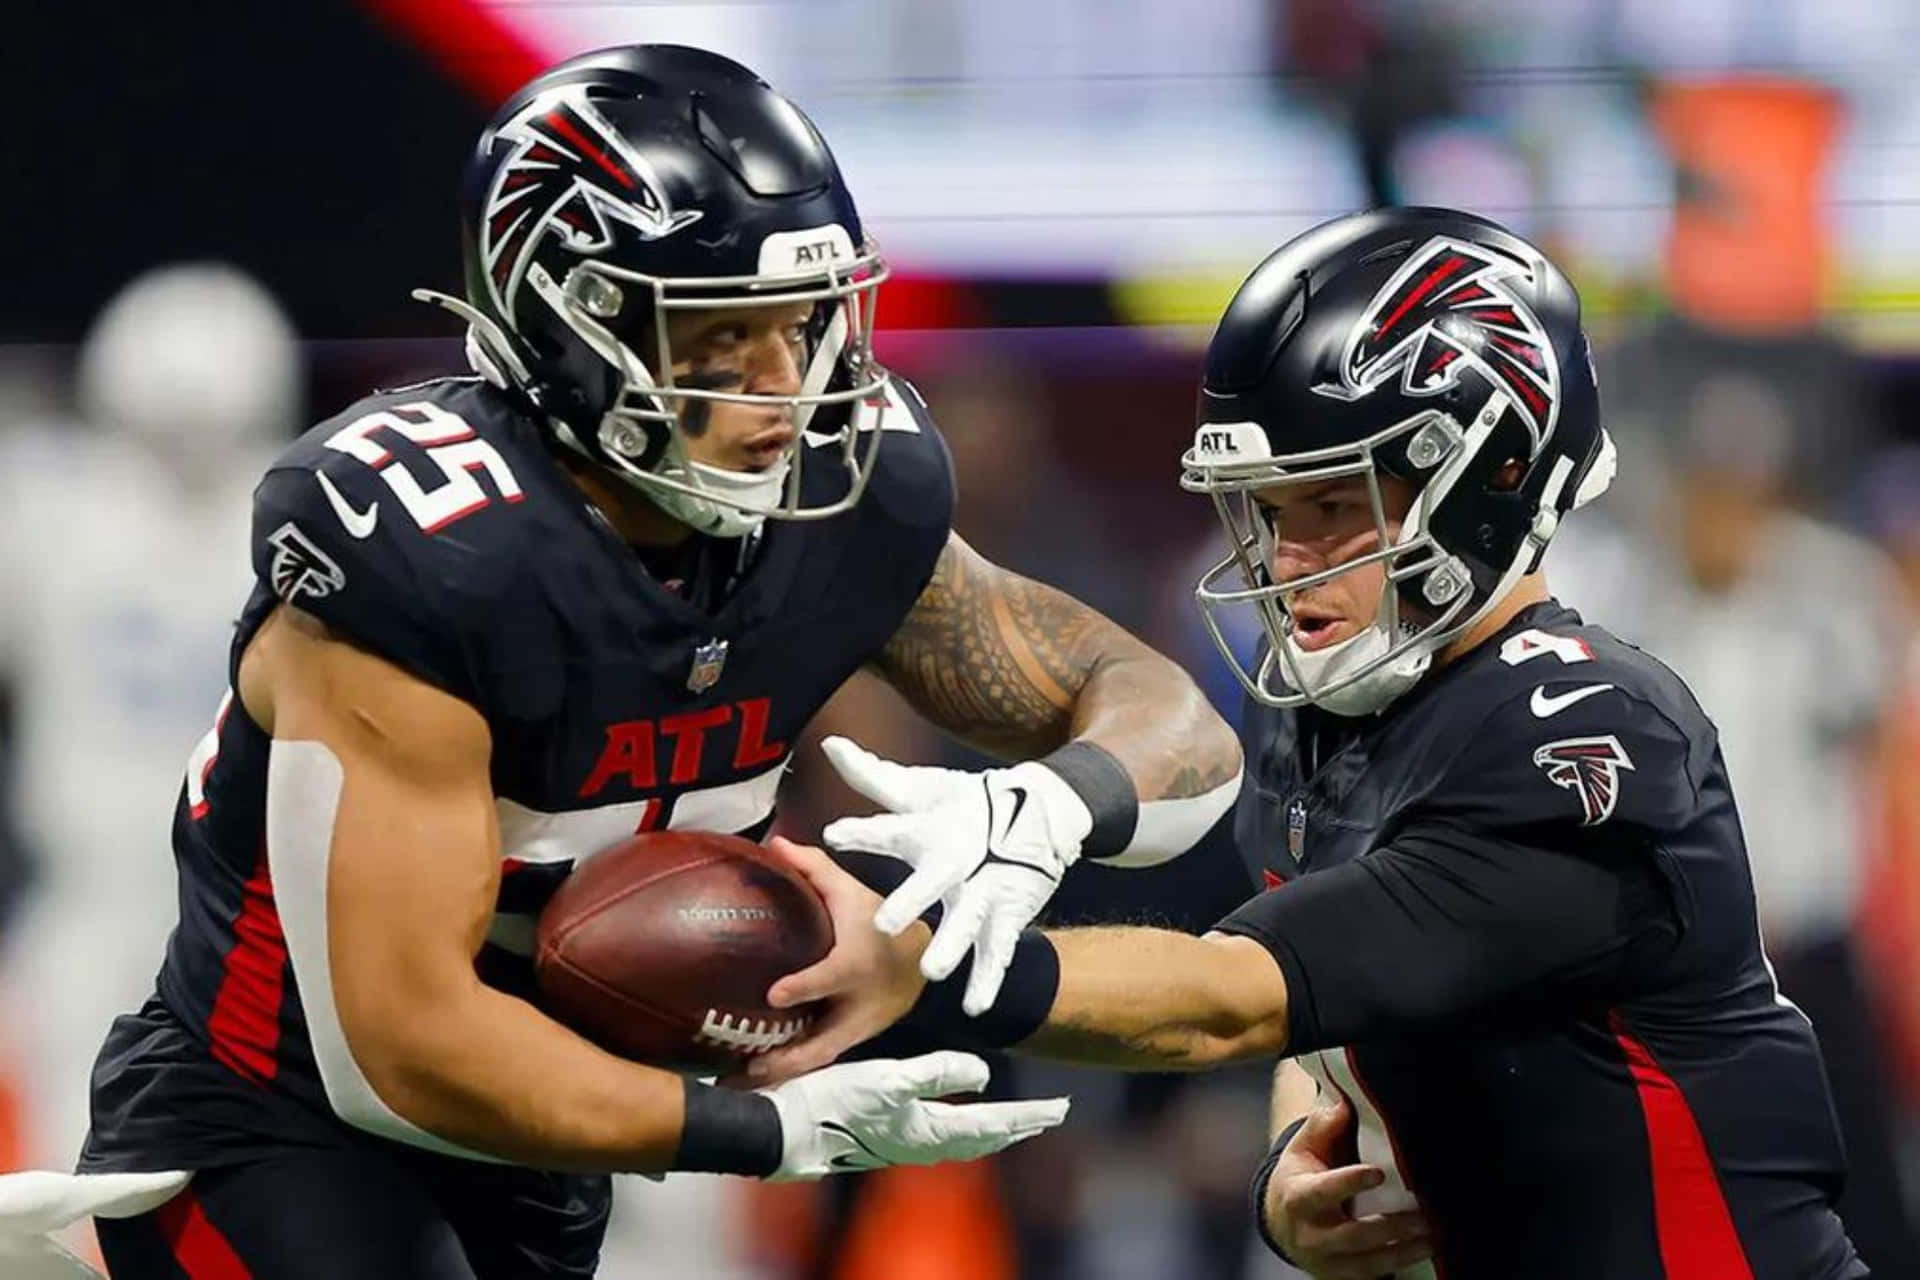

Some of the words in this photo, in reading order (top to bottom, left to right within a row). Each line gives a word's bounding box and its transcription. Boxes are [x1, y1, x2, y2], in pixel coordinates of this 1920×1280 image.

[795, 240, 840, 265] ATL
[1201, 433, 1237, 451] ATL
[323, 401, 527, 535] 25
[1500, 629, 1597, 666] 4
[579, 698, 785, 796] ATL
